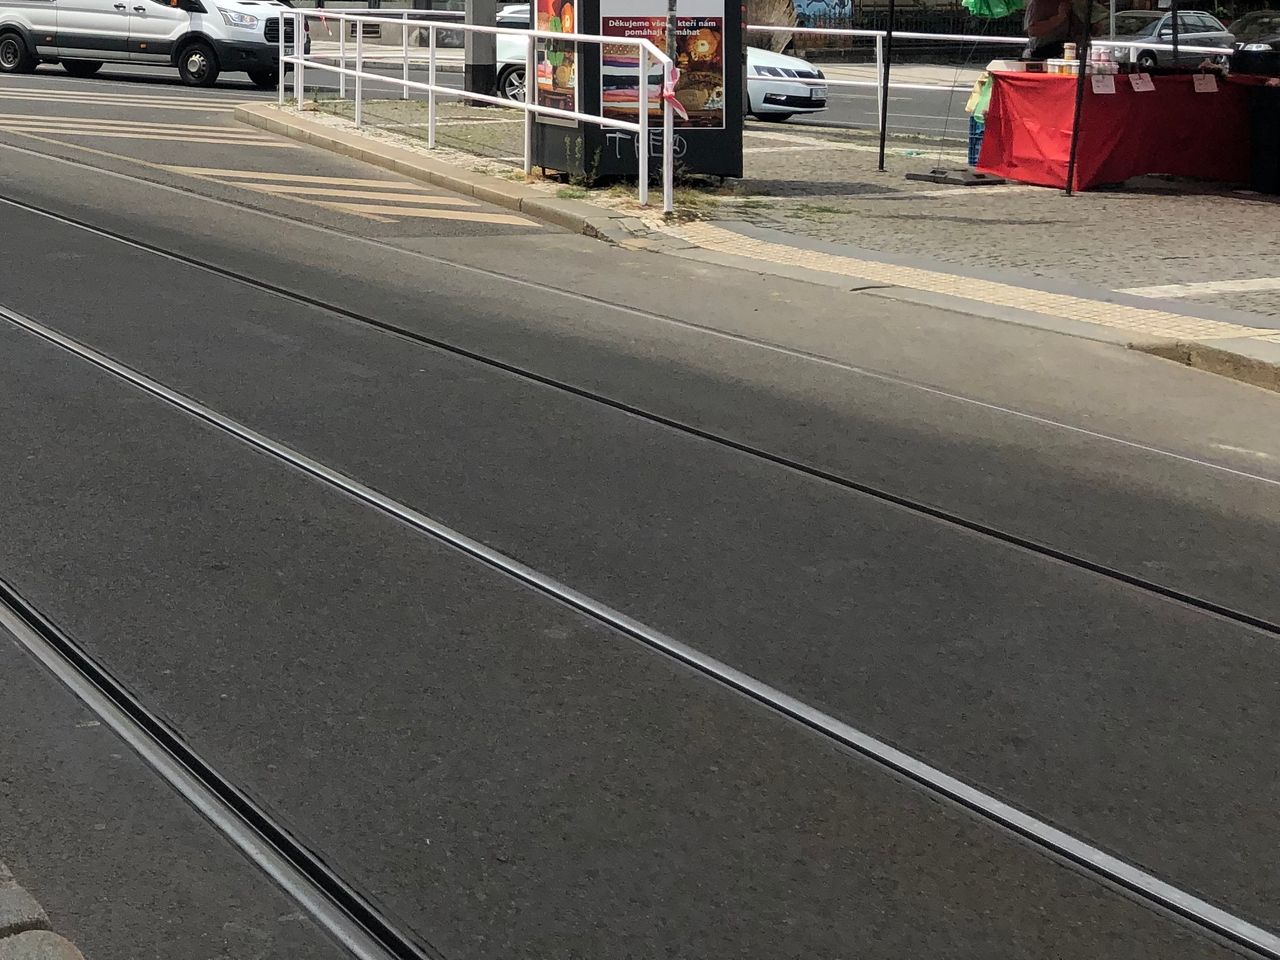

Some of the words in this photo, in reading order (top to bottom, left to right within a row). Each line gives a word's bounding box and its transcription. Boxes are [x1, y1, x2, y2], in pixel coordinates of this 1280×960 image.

[608, 19, 650, 29] Děkujeme
[677, 19, 697, 28] kteří
[699, 18, 717, 28] nám
[624, 27, 663, 37] pomáhají
